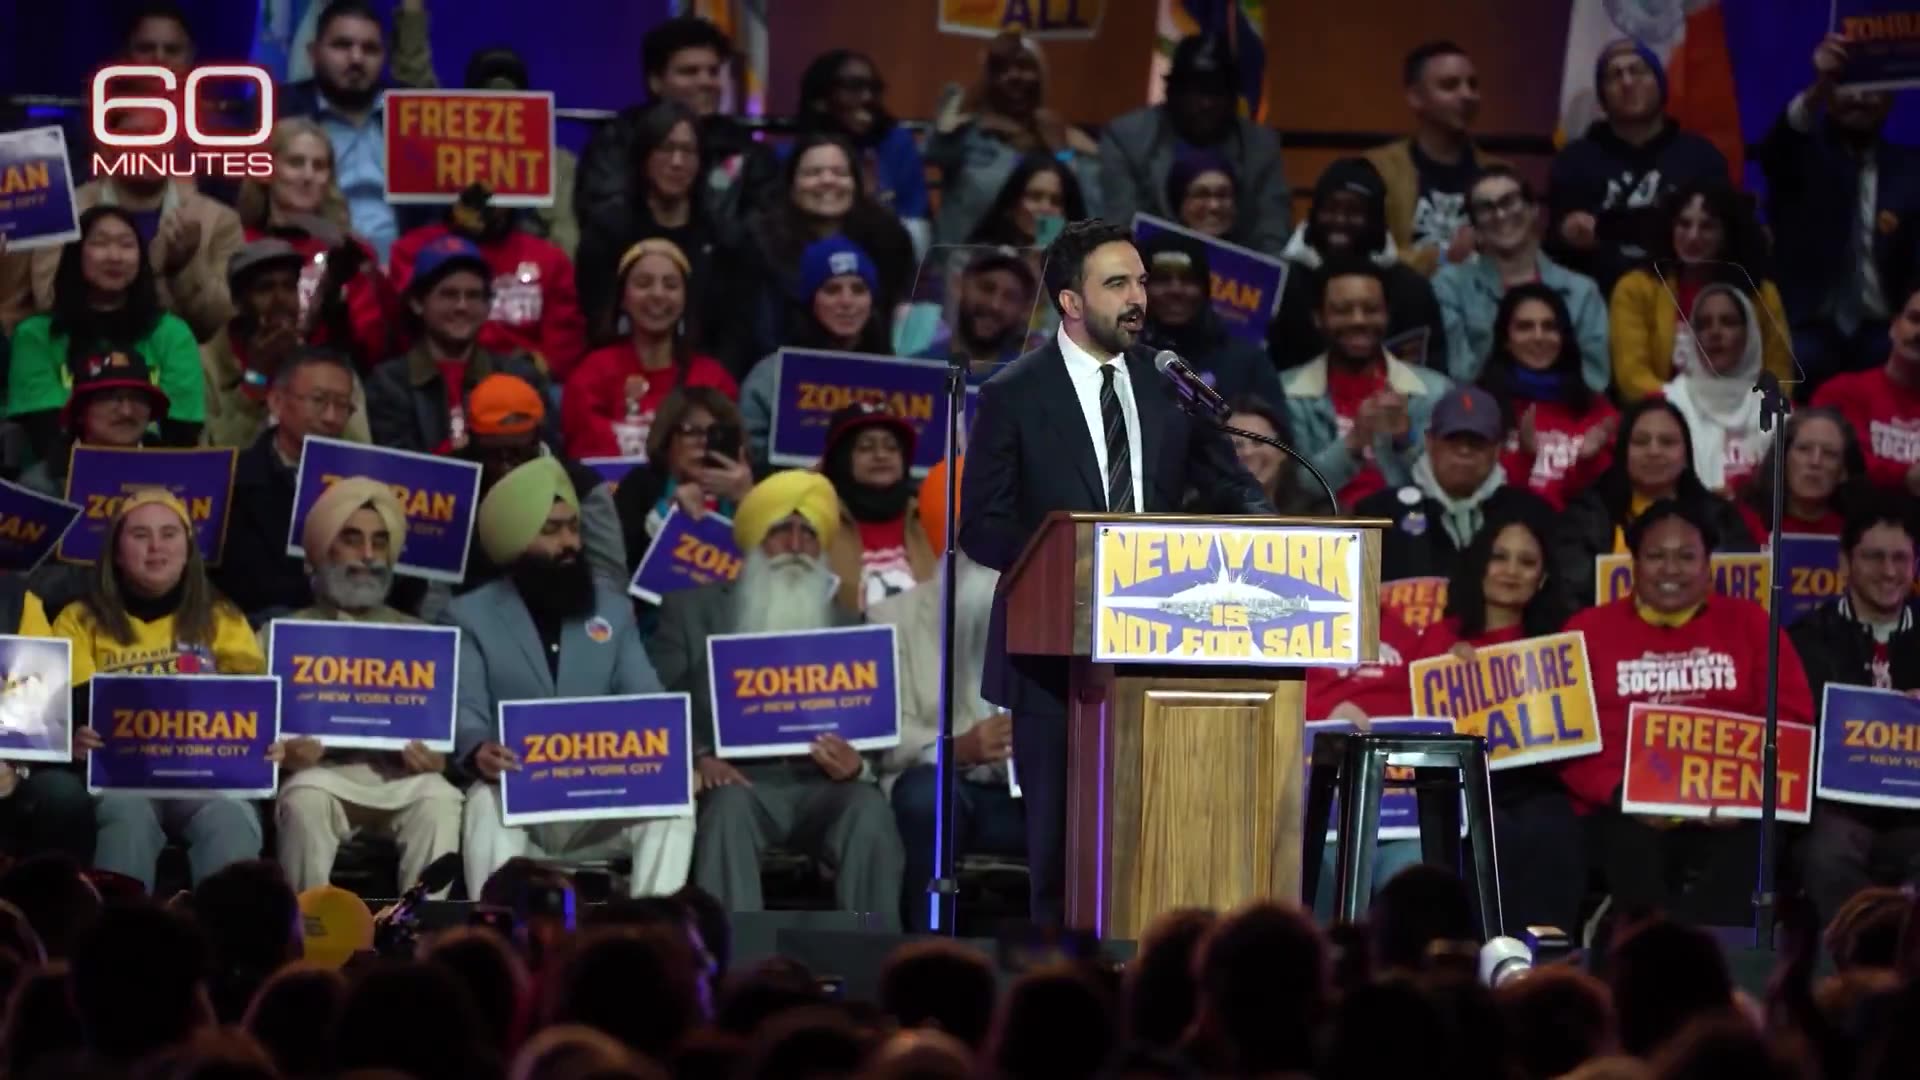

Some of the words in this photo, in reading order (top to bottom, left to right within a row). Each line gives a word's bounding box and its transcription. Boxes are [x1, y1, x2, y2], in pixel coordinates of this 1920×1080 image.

[400, 101, 526, 145] FREEZE
[435, 143, 545, 191] RENT
[320, 473, 457, 522] ZRAN
[673, 533, 743, 580] ZOH
[1104, 532, 1213, 597] NEW
[1220, 532, 1352, 601] YORK
[1102, 607, 1172, 657] NOT
[1181, 627, 1251, 657] FOR
[1262, 613, 1353, 659] SALE
[1211, 603, 1248, 627] IS
[291, 655, 437, 690] ZOHRAN
[732, 659, 879, 699] ZOHRAN
[1423, 643, 1578, 719] CHILDCARE
[1616, 666, 1738, 696] SOCIALISTS
[394, 694, 428, 707] CITY
[840, 694, 873, 709] CITY
[112, 708, 259, 740] ZOHRAN
[1487, 693, 1583, 753] ALL
[176, 743, 213, 758] YORK
[217, 744, 250, 758] CITY
[523, 727, 670, 765] ZOHRAN
[629, 762, 664, 776] CITY
[1680, 754, 1799, 806] RENT
